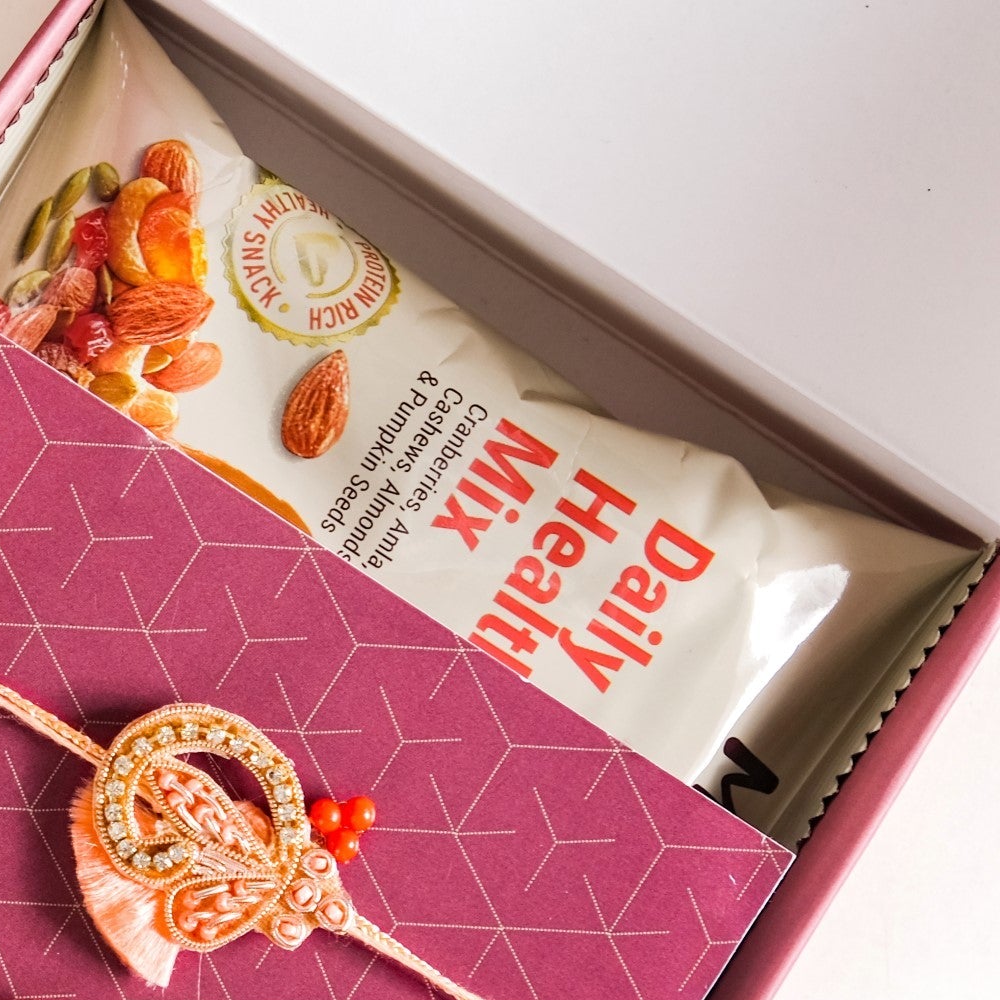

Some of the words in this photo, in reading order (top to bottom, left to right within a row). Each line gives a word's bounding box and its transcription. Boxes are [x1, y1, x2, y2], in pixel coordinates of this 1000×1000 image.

[252, 191, 331, 230] HEALTHY
[241, 231, 282, 309] SNACK
[354, 241, 387, 309] PROTEIN
[309, 298, 360, 330] RICH
[416, 370, 439, 387] &
[360, 388, 428, 472] Pumpkin
[390, 387, 463, 473] Cashews,
[399, 403, 488, 512] Cranberries,
[320, 474, 370, 533] Seeds
[430, 417, 560, 552] Mix
[361, 517, 410, 569] Amla,
[558, 518, 716, 694] Daily
